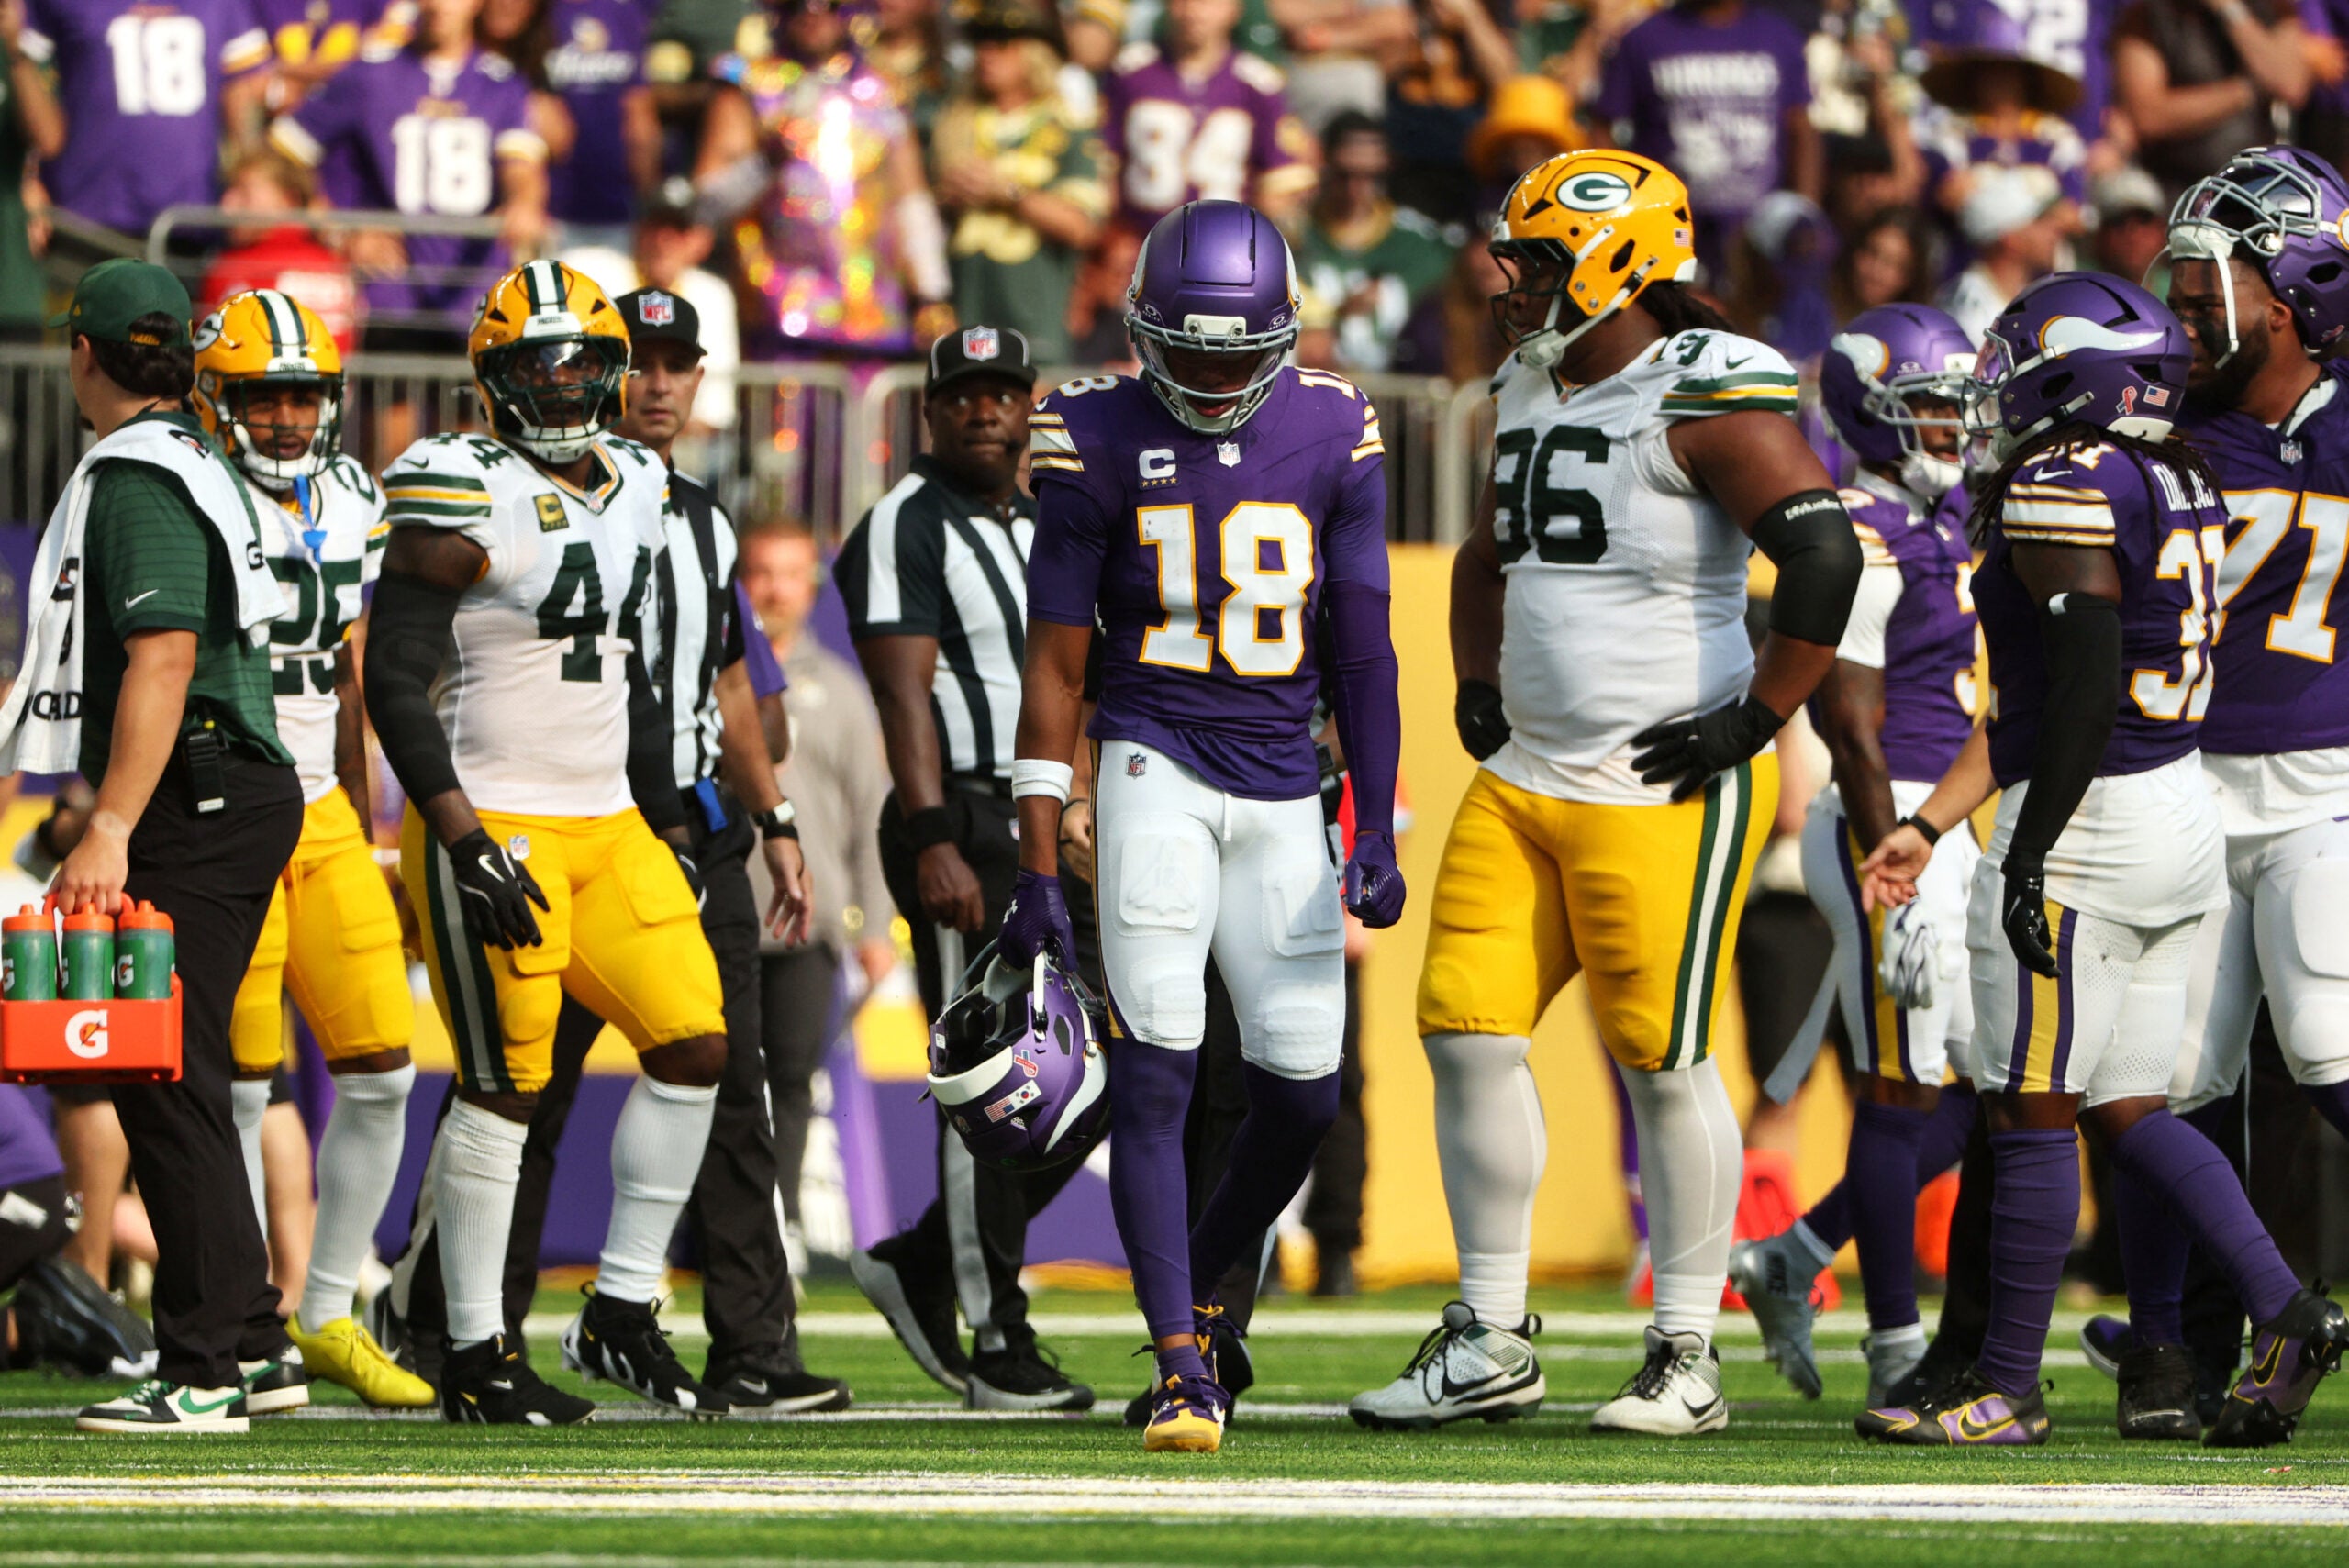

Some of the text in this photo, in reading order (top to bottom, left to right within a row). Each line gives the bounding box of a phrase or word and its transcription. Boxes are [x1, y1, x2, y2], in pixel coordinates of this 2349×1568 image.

[107, 15, 206, 116] 18
[392, 114, 493, 216] 18
[1139, 448, 1176, 479] C
[535, 495, 564, 523] C
[1137, 501, 1315, 676] 18
[65, 1009, 108, 1059] G
